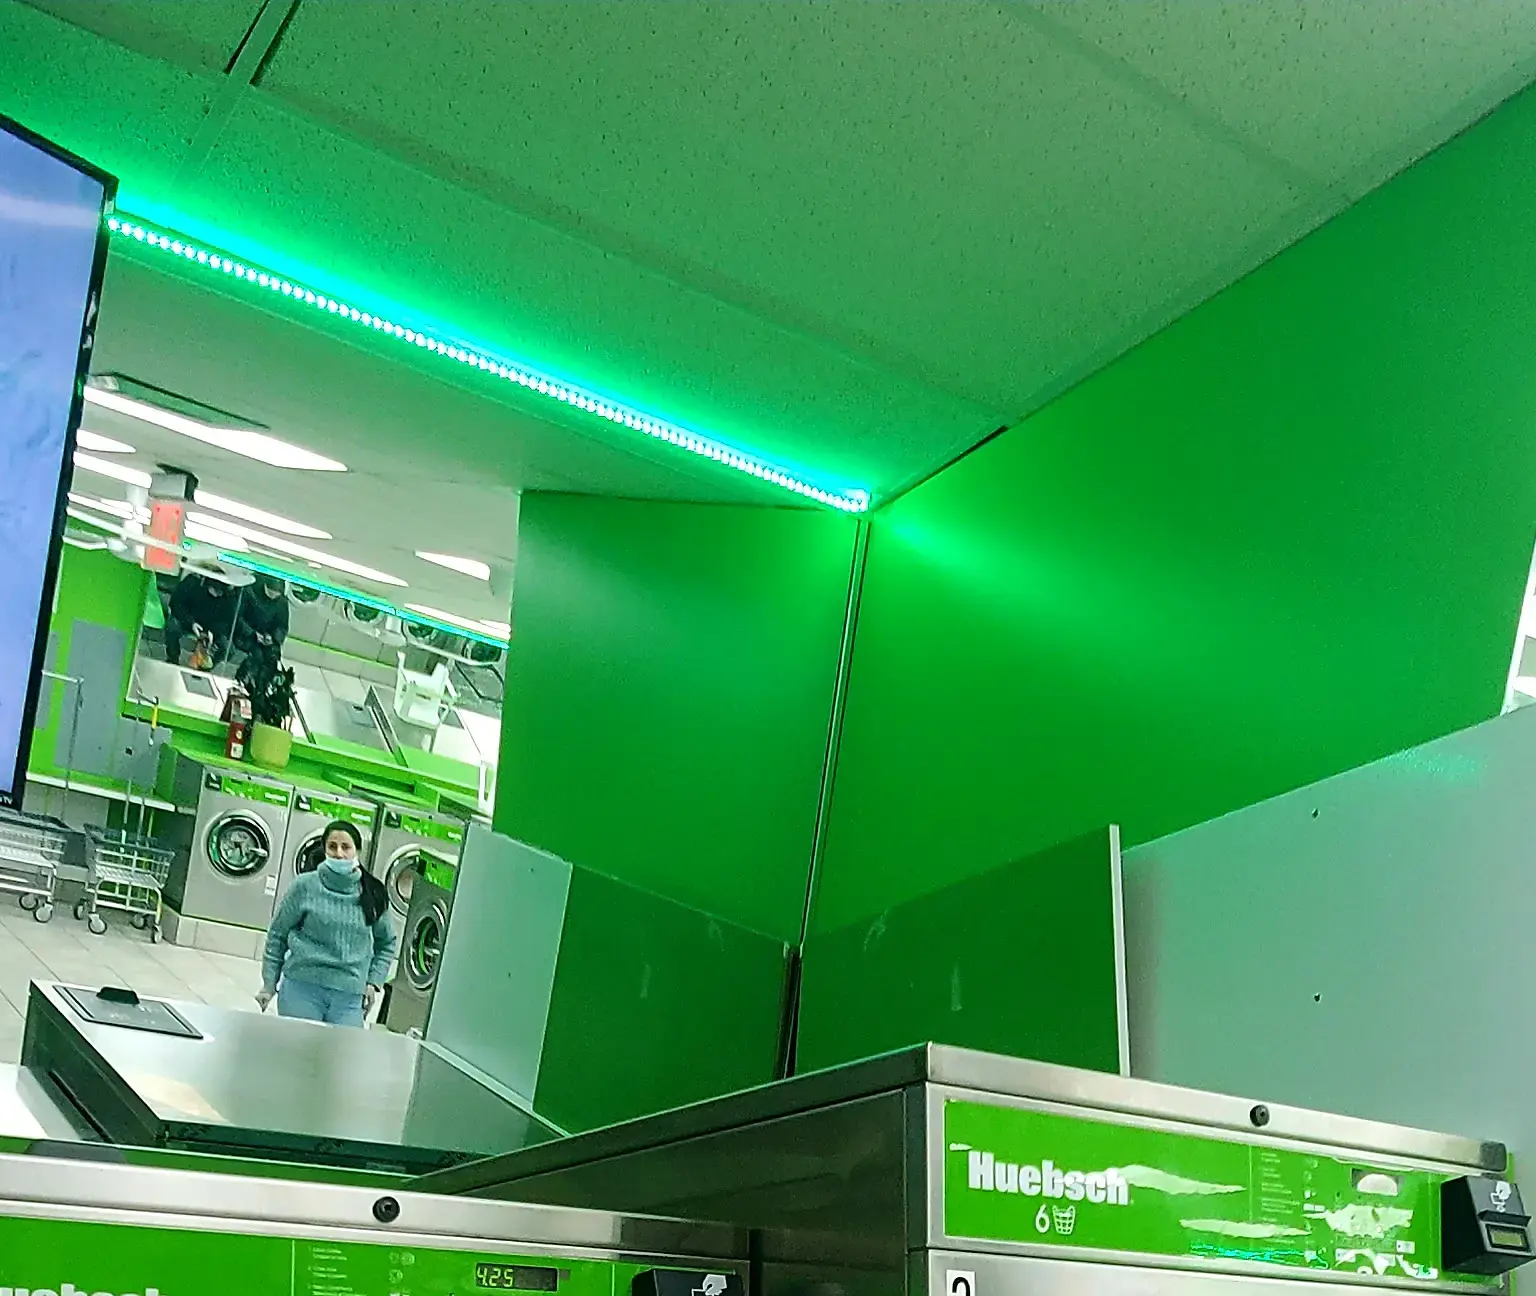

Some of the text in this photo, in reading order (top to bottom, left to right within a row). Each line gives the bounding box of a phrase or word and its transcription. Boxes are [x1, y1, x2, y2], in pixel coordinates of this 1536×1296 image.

[967, 1149, 1130, 1206] Huebsch
[1034, 1204, 1051, 1235] 6
[475, 1264, 515, 1289] 4.25
